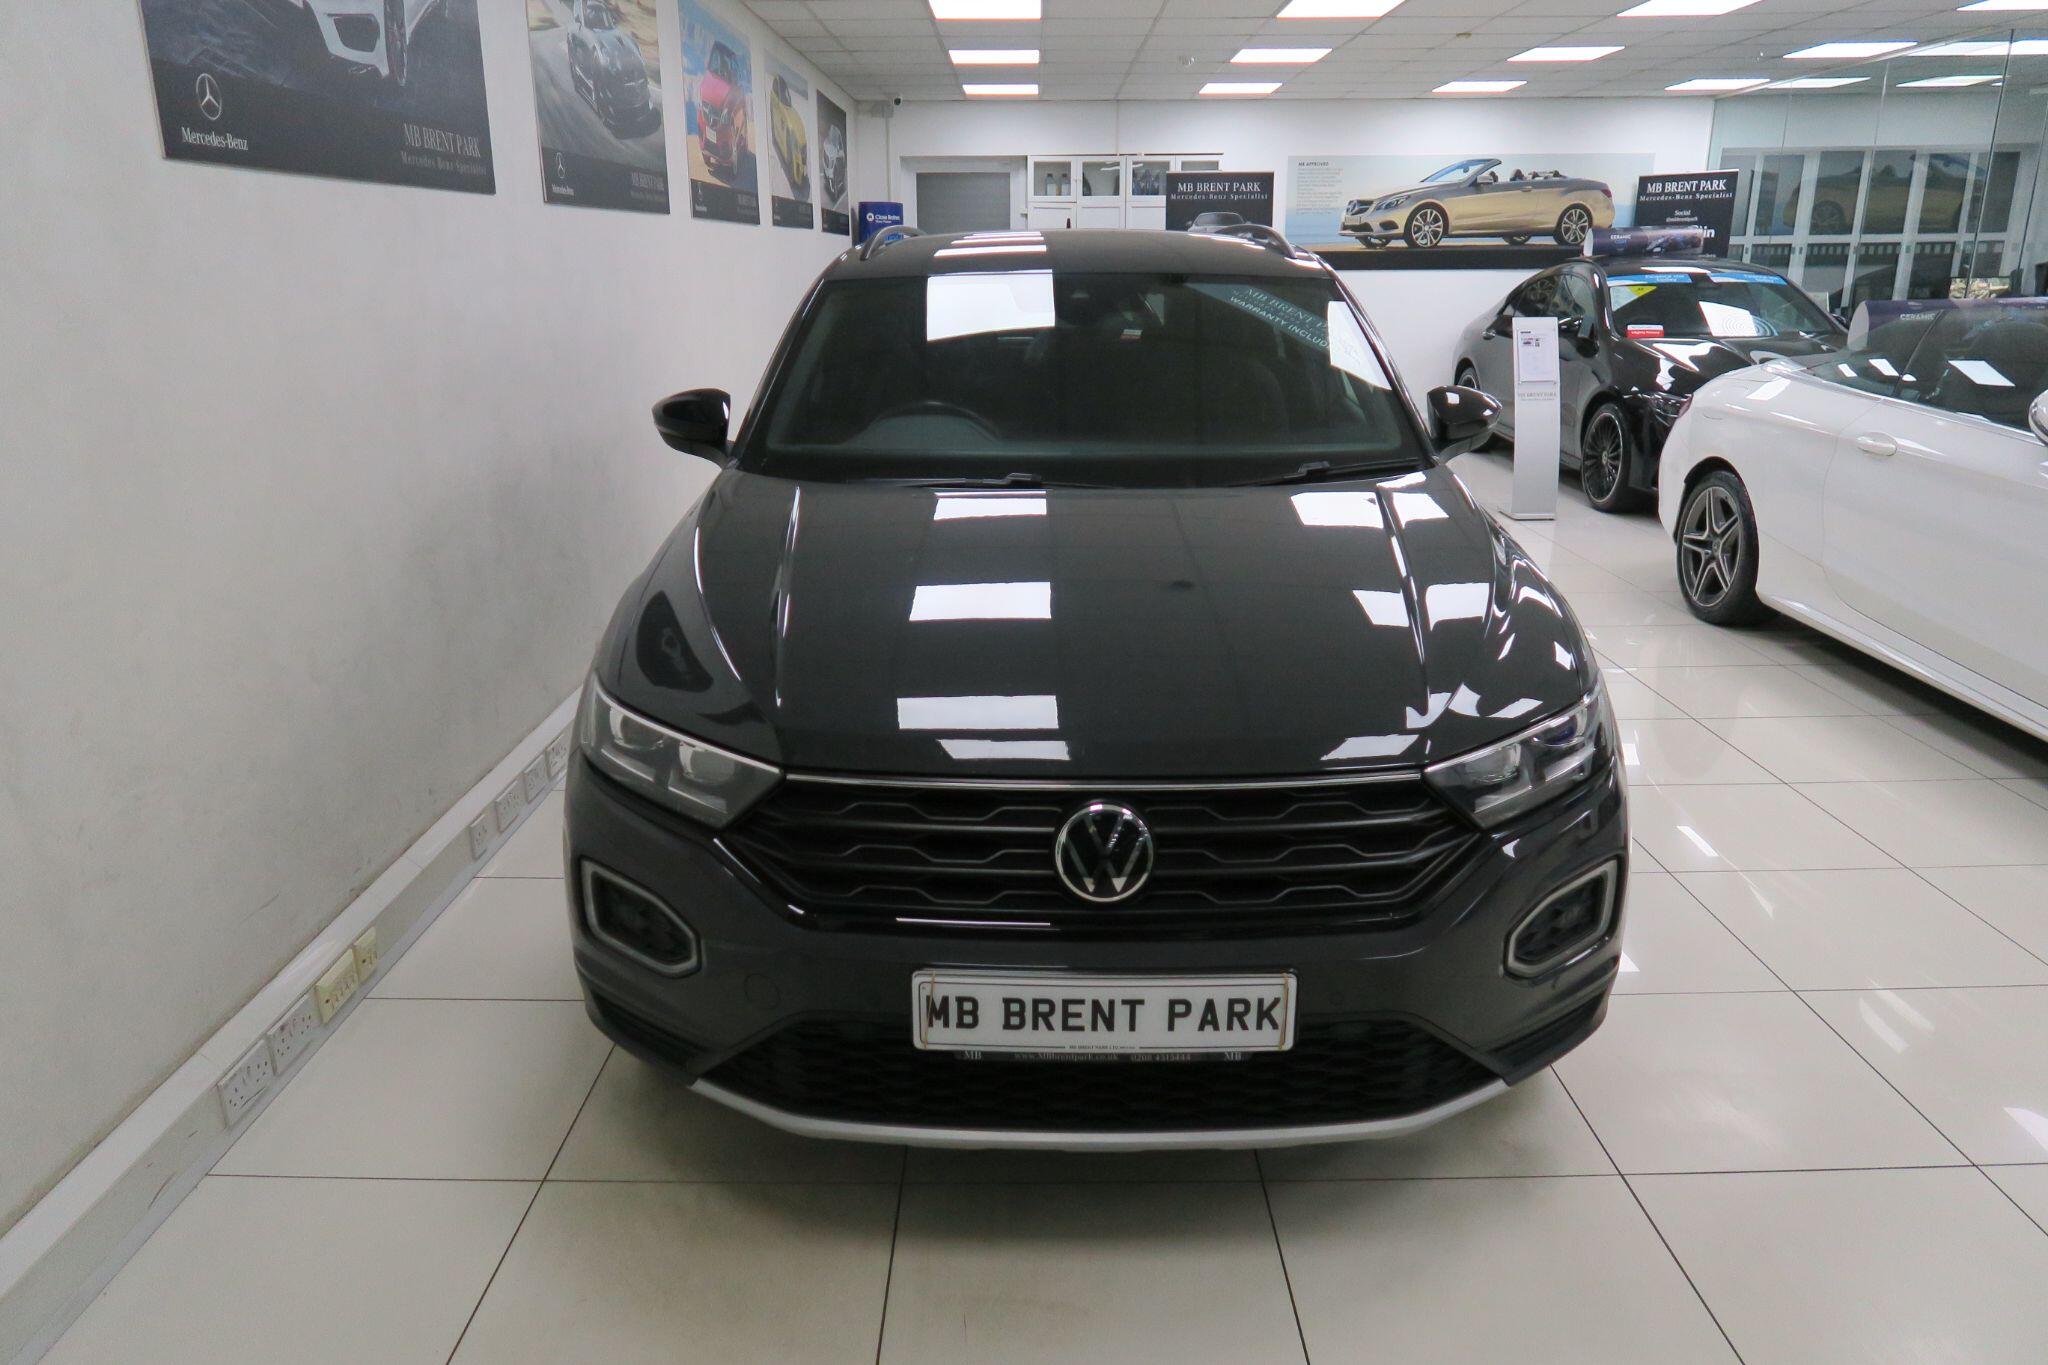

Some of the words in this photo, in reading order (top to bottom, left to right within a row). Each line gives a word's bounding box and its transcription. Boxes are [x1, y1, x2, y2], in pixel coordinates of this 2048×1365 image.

[181, 126, 248, 151] Mercedes-Benz
[403, 122, 422, 147] MB
[422, 127, 454, 153] BRENT
[455, 134, 481, 158] PARK
[1177, 182, 1194, 192] MB
[1196, 182, 1231, 192] BRENT
[1233, 182, 1261, 192] PARK
[1646, 182, 1663, 194] MB
[1664, 180, 1699, 193] BRENT
[1699, 179, 1727, 191] PARK
[1695, 191, 1733, 200] Specialist
[1230, 296, 1289, 326] WARRANTY
[1287, 324, 1330, 348] INCLUD
[925, 995, 980, 1030] MB
[1002, 997, 1145, 1032] BRENT
[1167, 997, 1281, 1032] PARK
